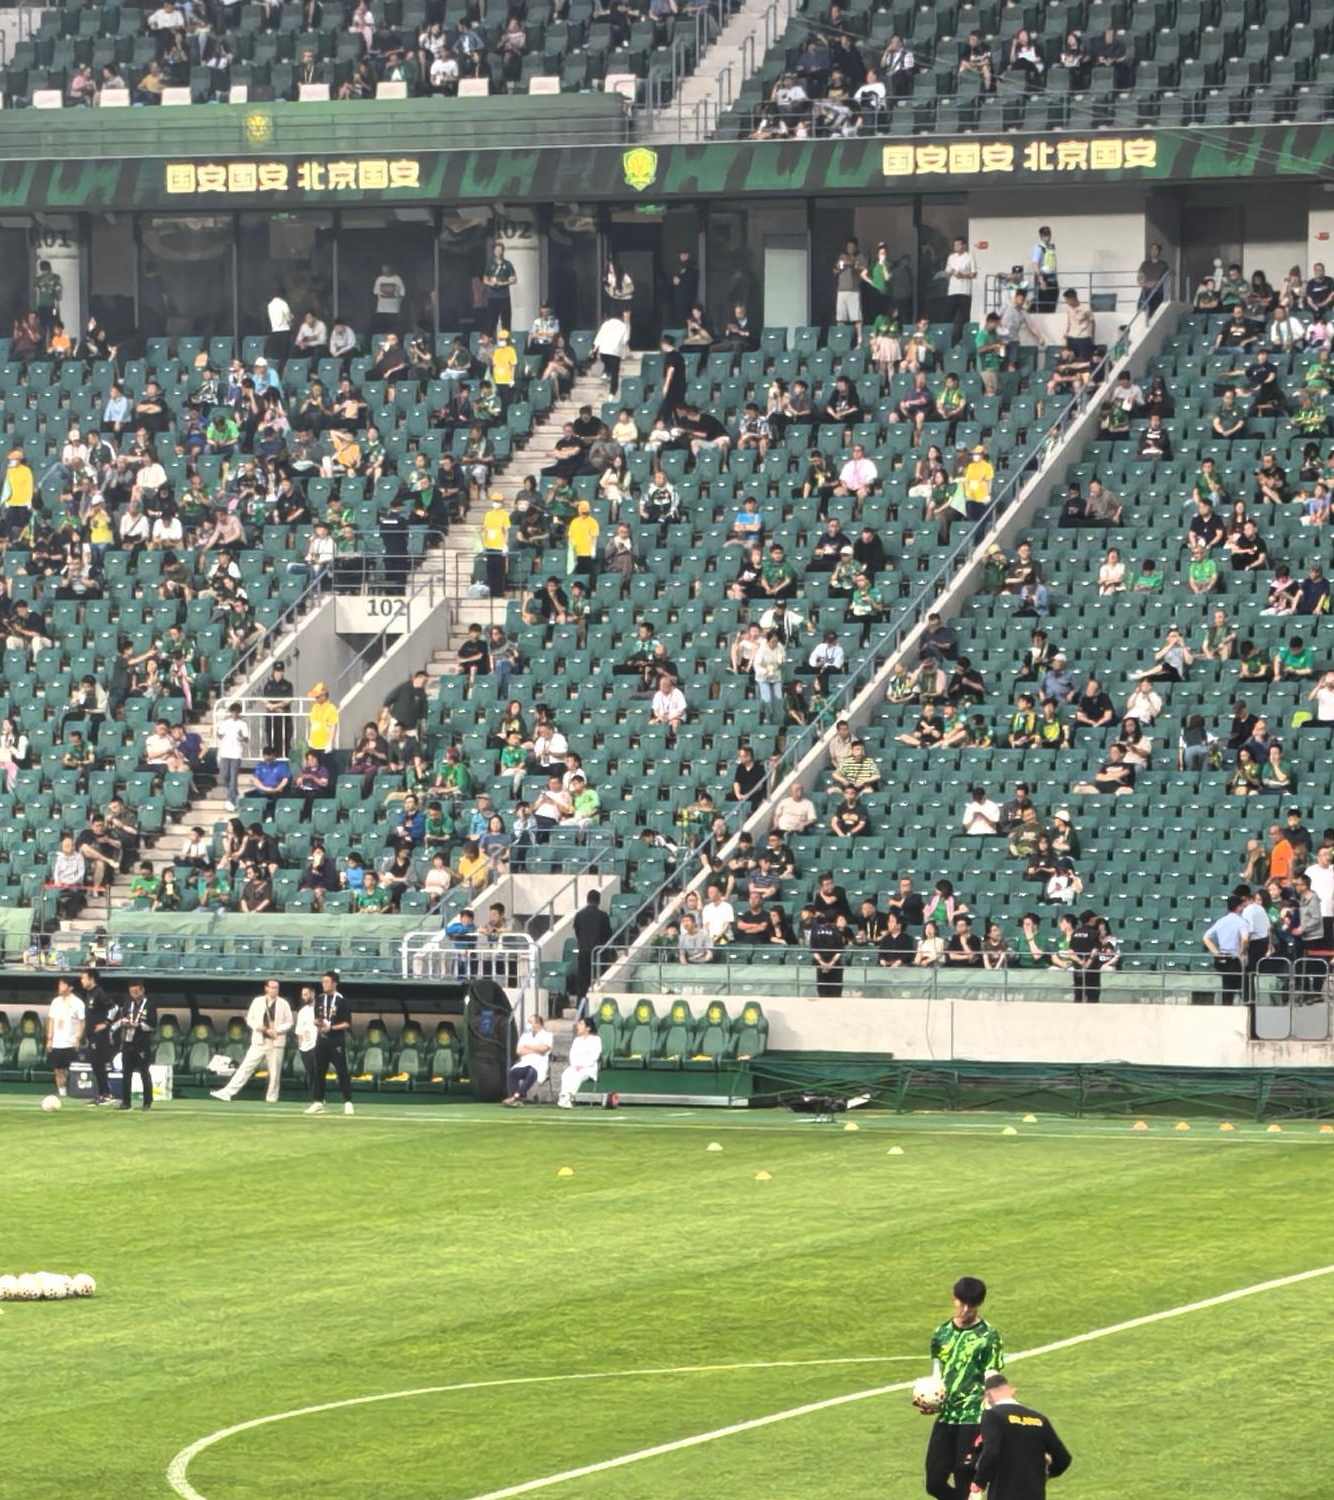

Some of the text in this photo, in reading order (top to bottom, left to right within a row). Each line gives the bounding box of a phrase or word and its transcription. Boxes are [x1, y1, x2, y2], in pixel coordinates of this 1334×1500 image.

[882, 138, 1157, 176] 国安国安 北京国安
[166, 158, 420, 193] 国安国安 北京国安
[367, 599, 407, 617] 102
